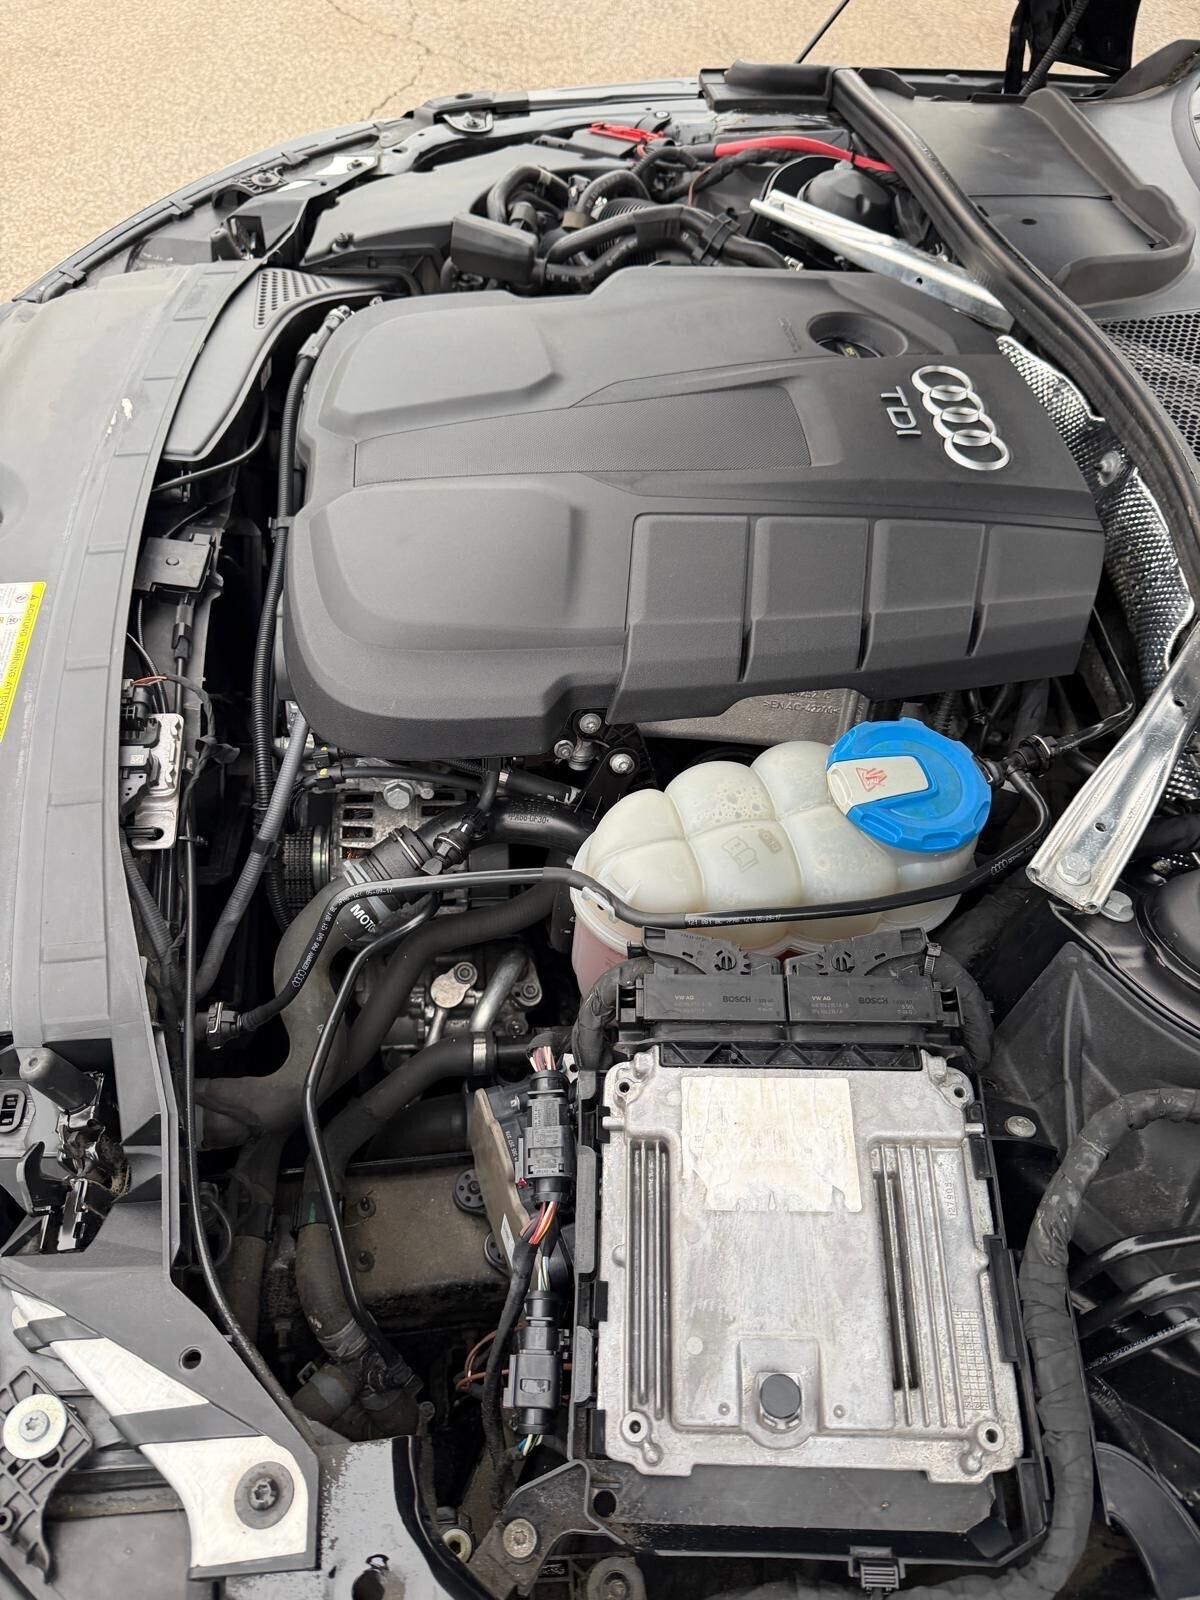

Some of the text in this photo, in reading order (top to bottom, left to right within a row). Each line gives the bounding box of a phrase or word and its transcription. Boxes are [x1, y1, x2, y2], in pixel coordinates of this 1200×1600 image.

[880, 386, 922, 436] TDI
[19, 603, 36, 638] ACHTUNG
[8, 641, 25, 678] WARNING
[722, 995, 752, 1003] BOSCH
[858, 996, 889, 1005] BOSCH
